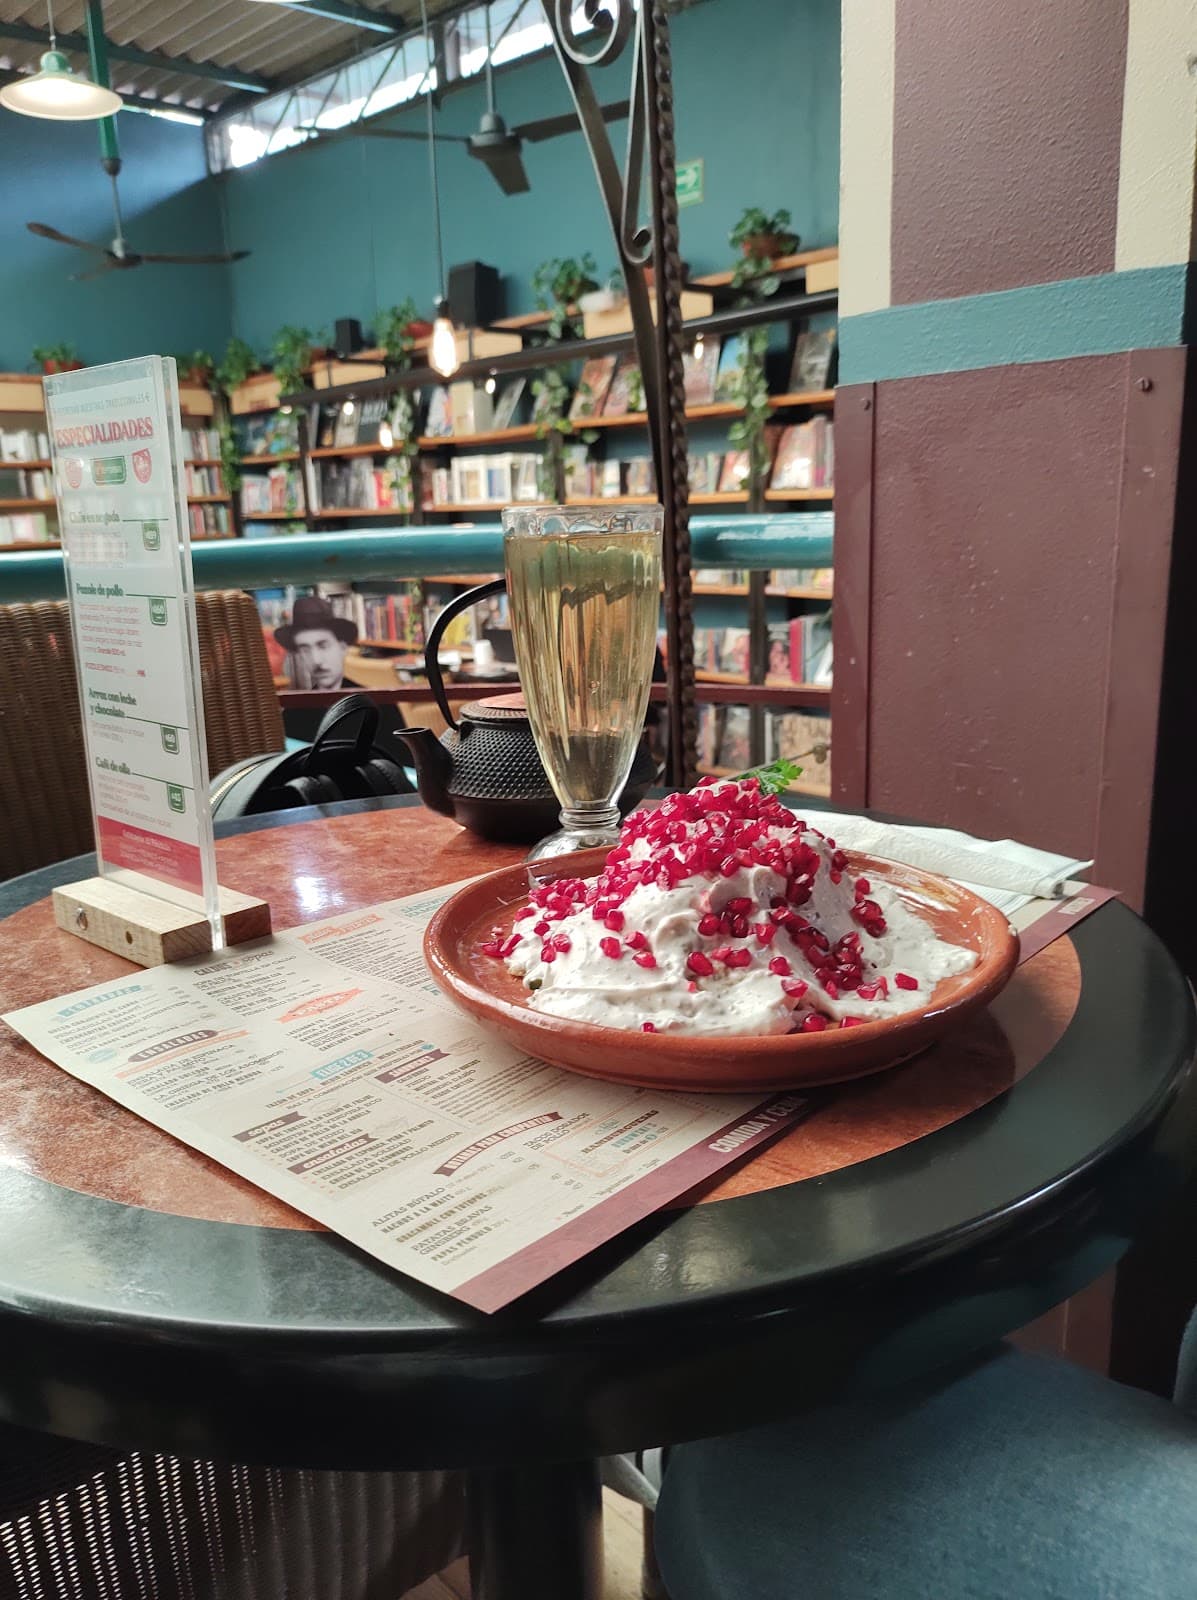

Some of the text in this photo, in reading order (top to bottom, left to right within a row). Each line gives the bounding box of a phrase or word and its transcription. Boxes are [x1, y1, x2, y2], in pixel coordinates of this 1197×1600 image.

[55, 416, 154, 449] ESPECIALIDADES
[106, 584, 124, 599] pollo
[136, 1031, 211, 1058] ENSALADAS
[247, 1119, 285, 1136] sopas
[580, 1109, 659, 1153] HAMBURGUESAS
[708, 1120, 771, 1154] COMIDA
[754, 1113, 778, 1123] Y
[302, 1137, 367, 1169] ensaladas
[370, 1185, 447, 1227] ALITAS BÚFALO
[380, 1215, 415, 1234] NACHOS
[410, 1204, 493, 1251] PATATAS BRAVAS
[430, 1245, 458, 1262] PAPAS
